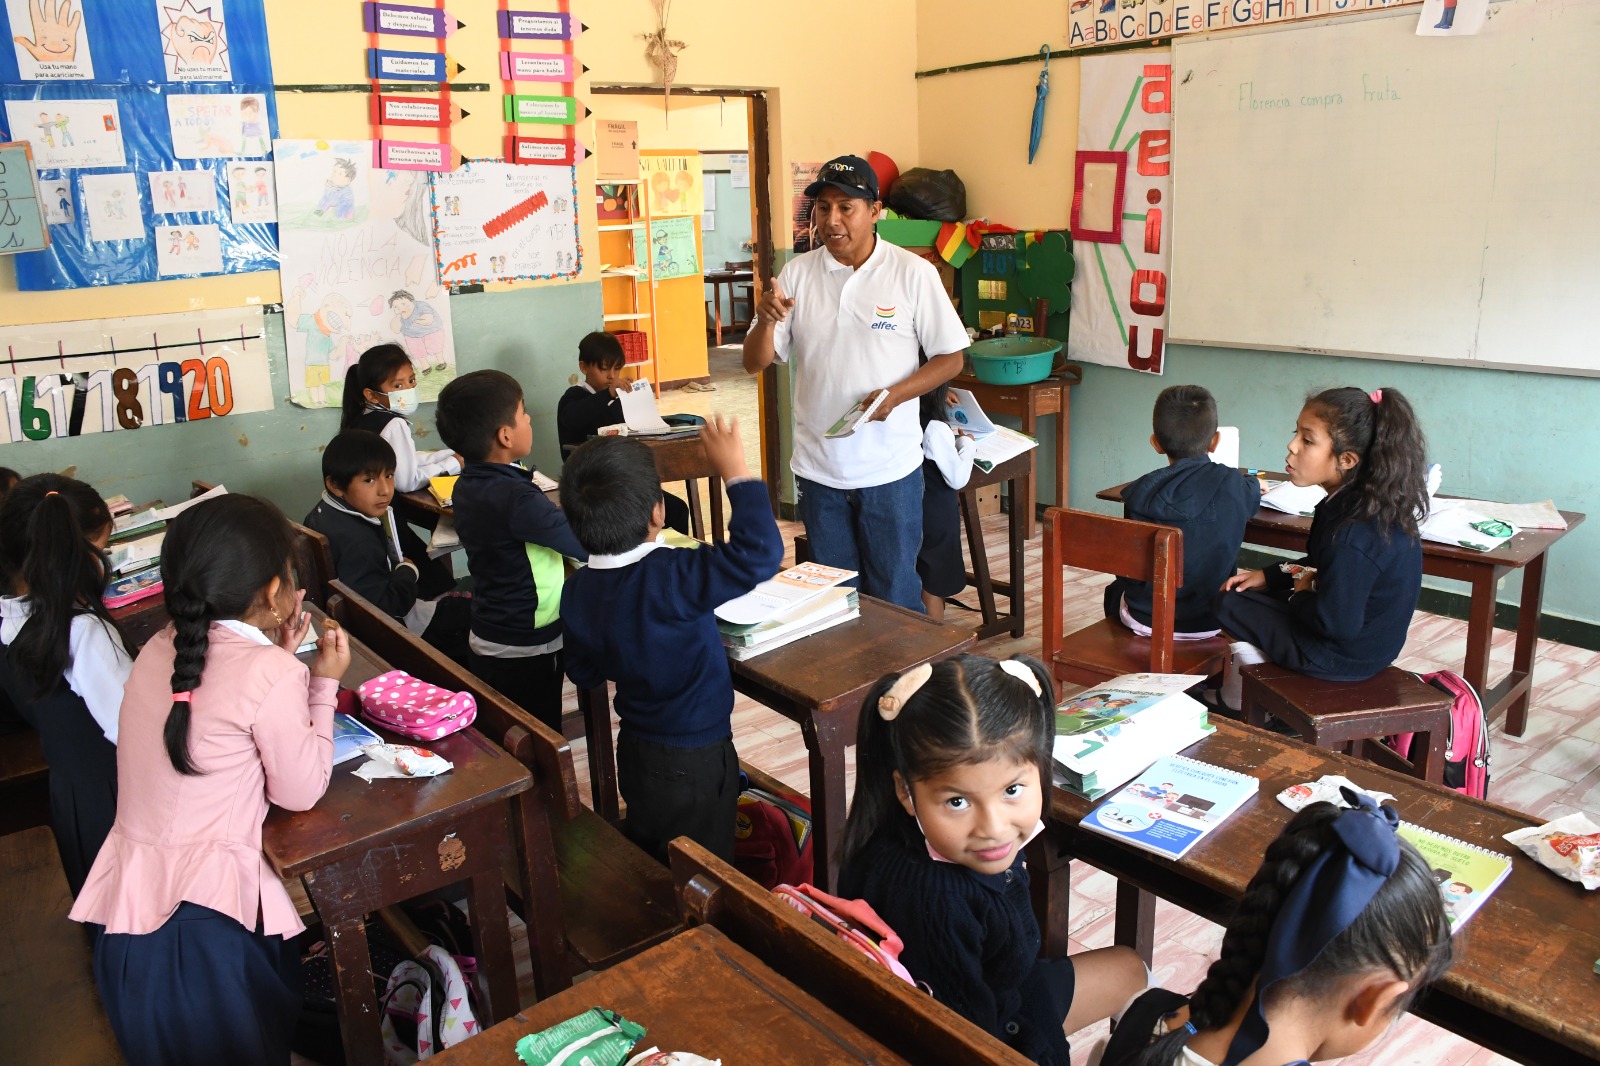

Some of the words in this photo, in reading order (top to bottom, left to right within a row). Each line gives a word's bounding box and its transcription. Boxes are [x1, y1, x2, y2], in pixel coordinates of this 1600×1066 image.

[382, 12, 409, 20] Debemos
[392, 21, 428, 30] despedirnos
[1238, 81, 1291, 110] Florencia
[1300, 92, 1344, 109] compra
[320, 232, 348, 263] NO
[313, 255, 401, 286] VIOLENCIA
[870, 320, 898, 331] elfec
[36, 372, 90, 438] 17
[87, 367, 144, 432] 18
[136, 361, 188, 426] 19
[181, 356, 234, 421] 20
